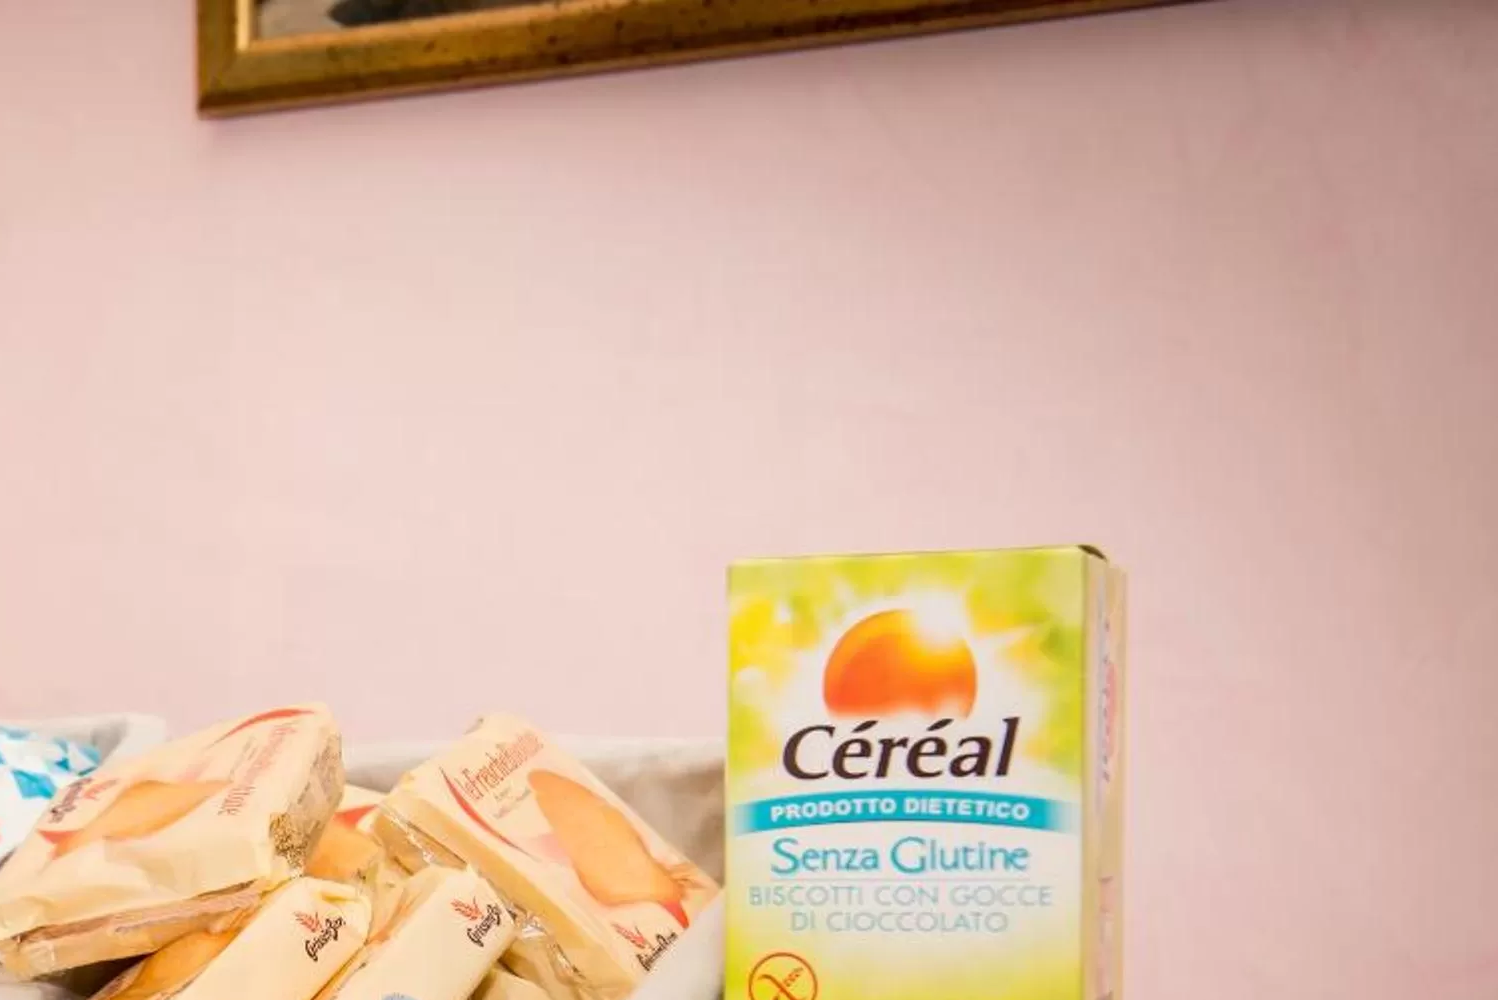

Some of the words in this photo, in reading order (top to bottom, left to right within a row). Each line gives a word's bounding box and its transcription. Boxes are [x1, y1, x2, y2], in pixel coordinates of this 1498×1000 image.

[783, 716, 1020, 780] Céréal
[771, 797, 896, 822] PRODOTTO
[904, 797, 1031, 821] DIETETICO
[771, 837, 880, 875] Senza
[890, 836, 1030, 874] Glutine
[749, 885, 864, 907] BISCOTTI
[874, 885, 939, 907] CON
[949, 885, 1052, 907] GOCCE
[791, 912, 815, 932] DI
[826, 911, 1008, 933] CIOCCOLATO
